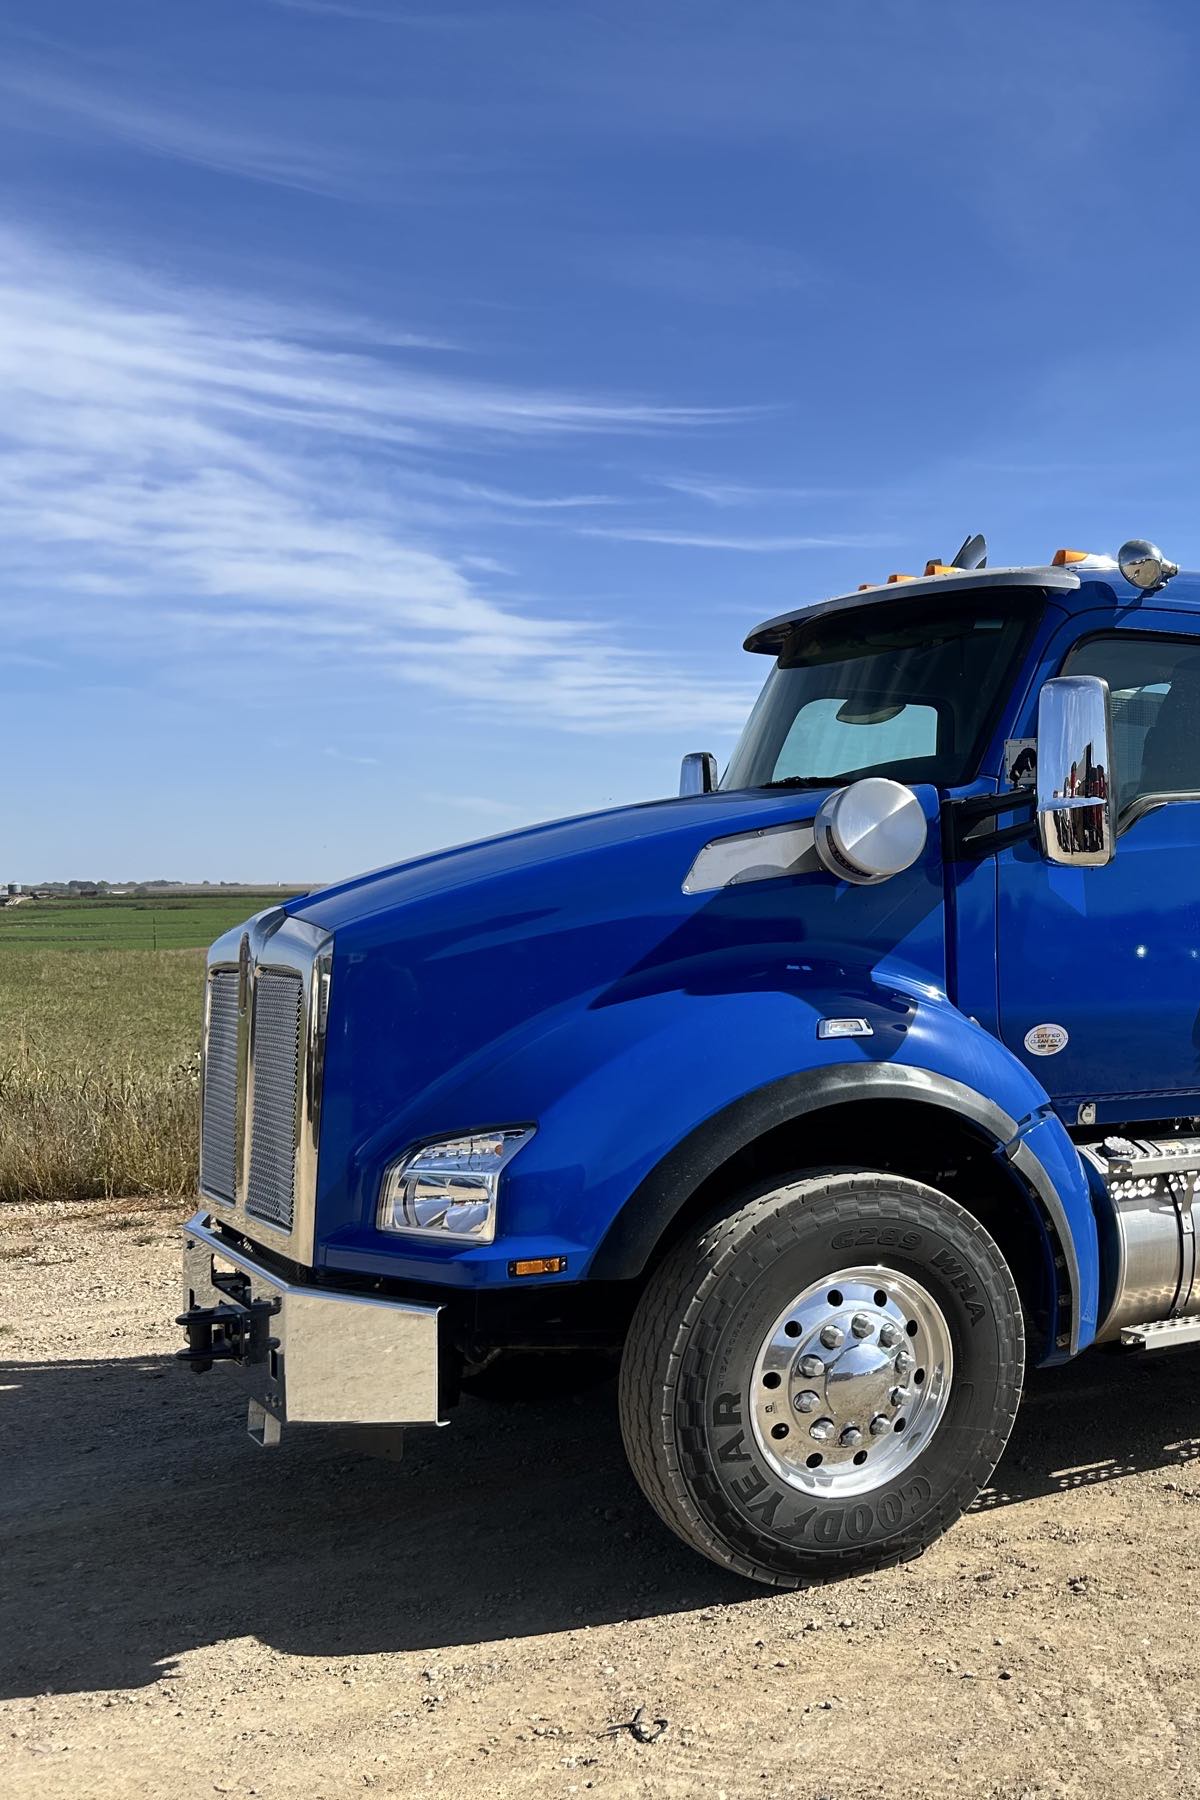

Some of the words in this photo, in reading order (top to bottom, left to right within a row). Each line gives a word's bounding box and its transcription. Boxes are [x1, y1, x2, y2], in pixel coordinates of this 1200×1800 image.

[831, 1226, 922, 1250] G289
[929, 1248, 986, 1327] WHA
[713, 1391, 932, 1543] GOODYEAR
